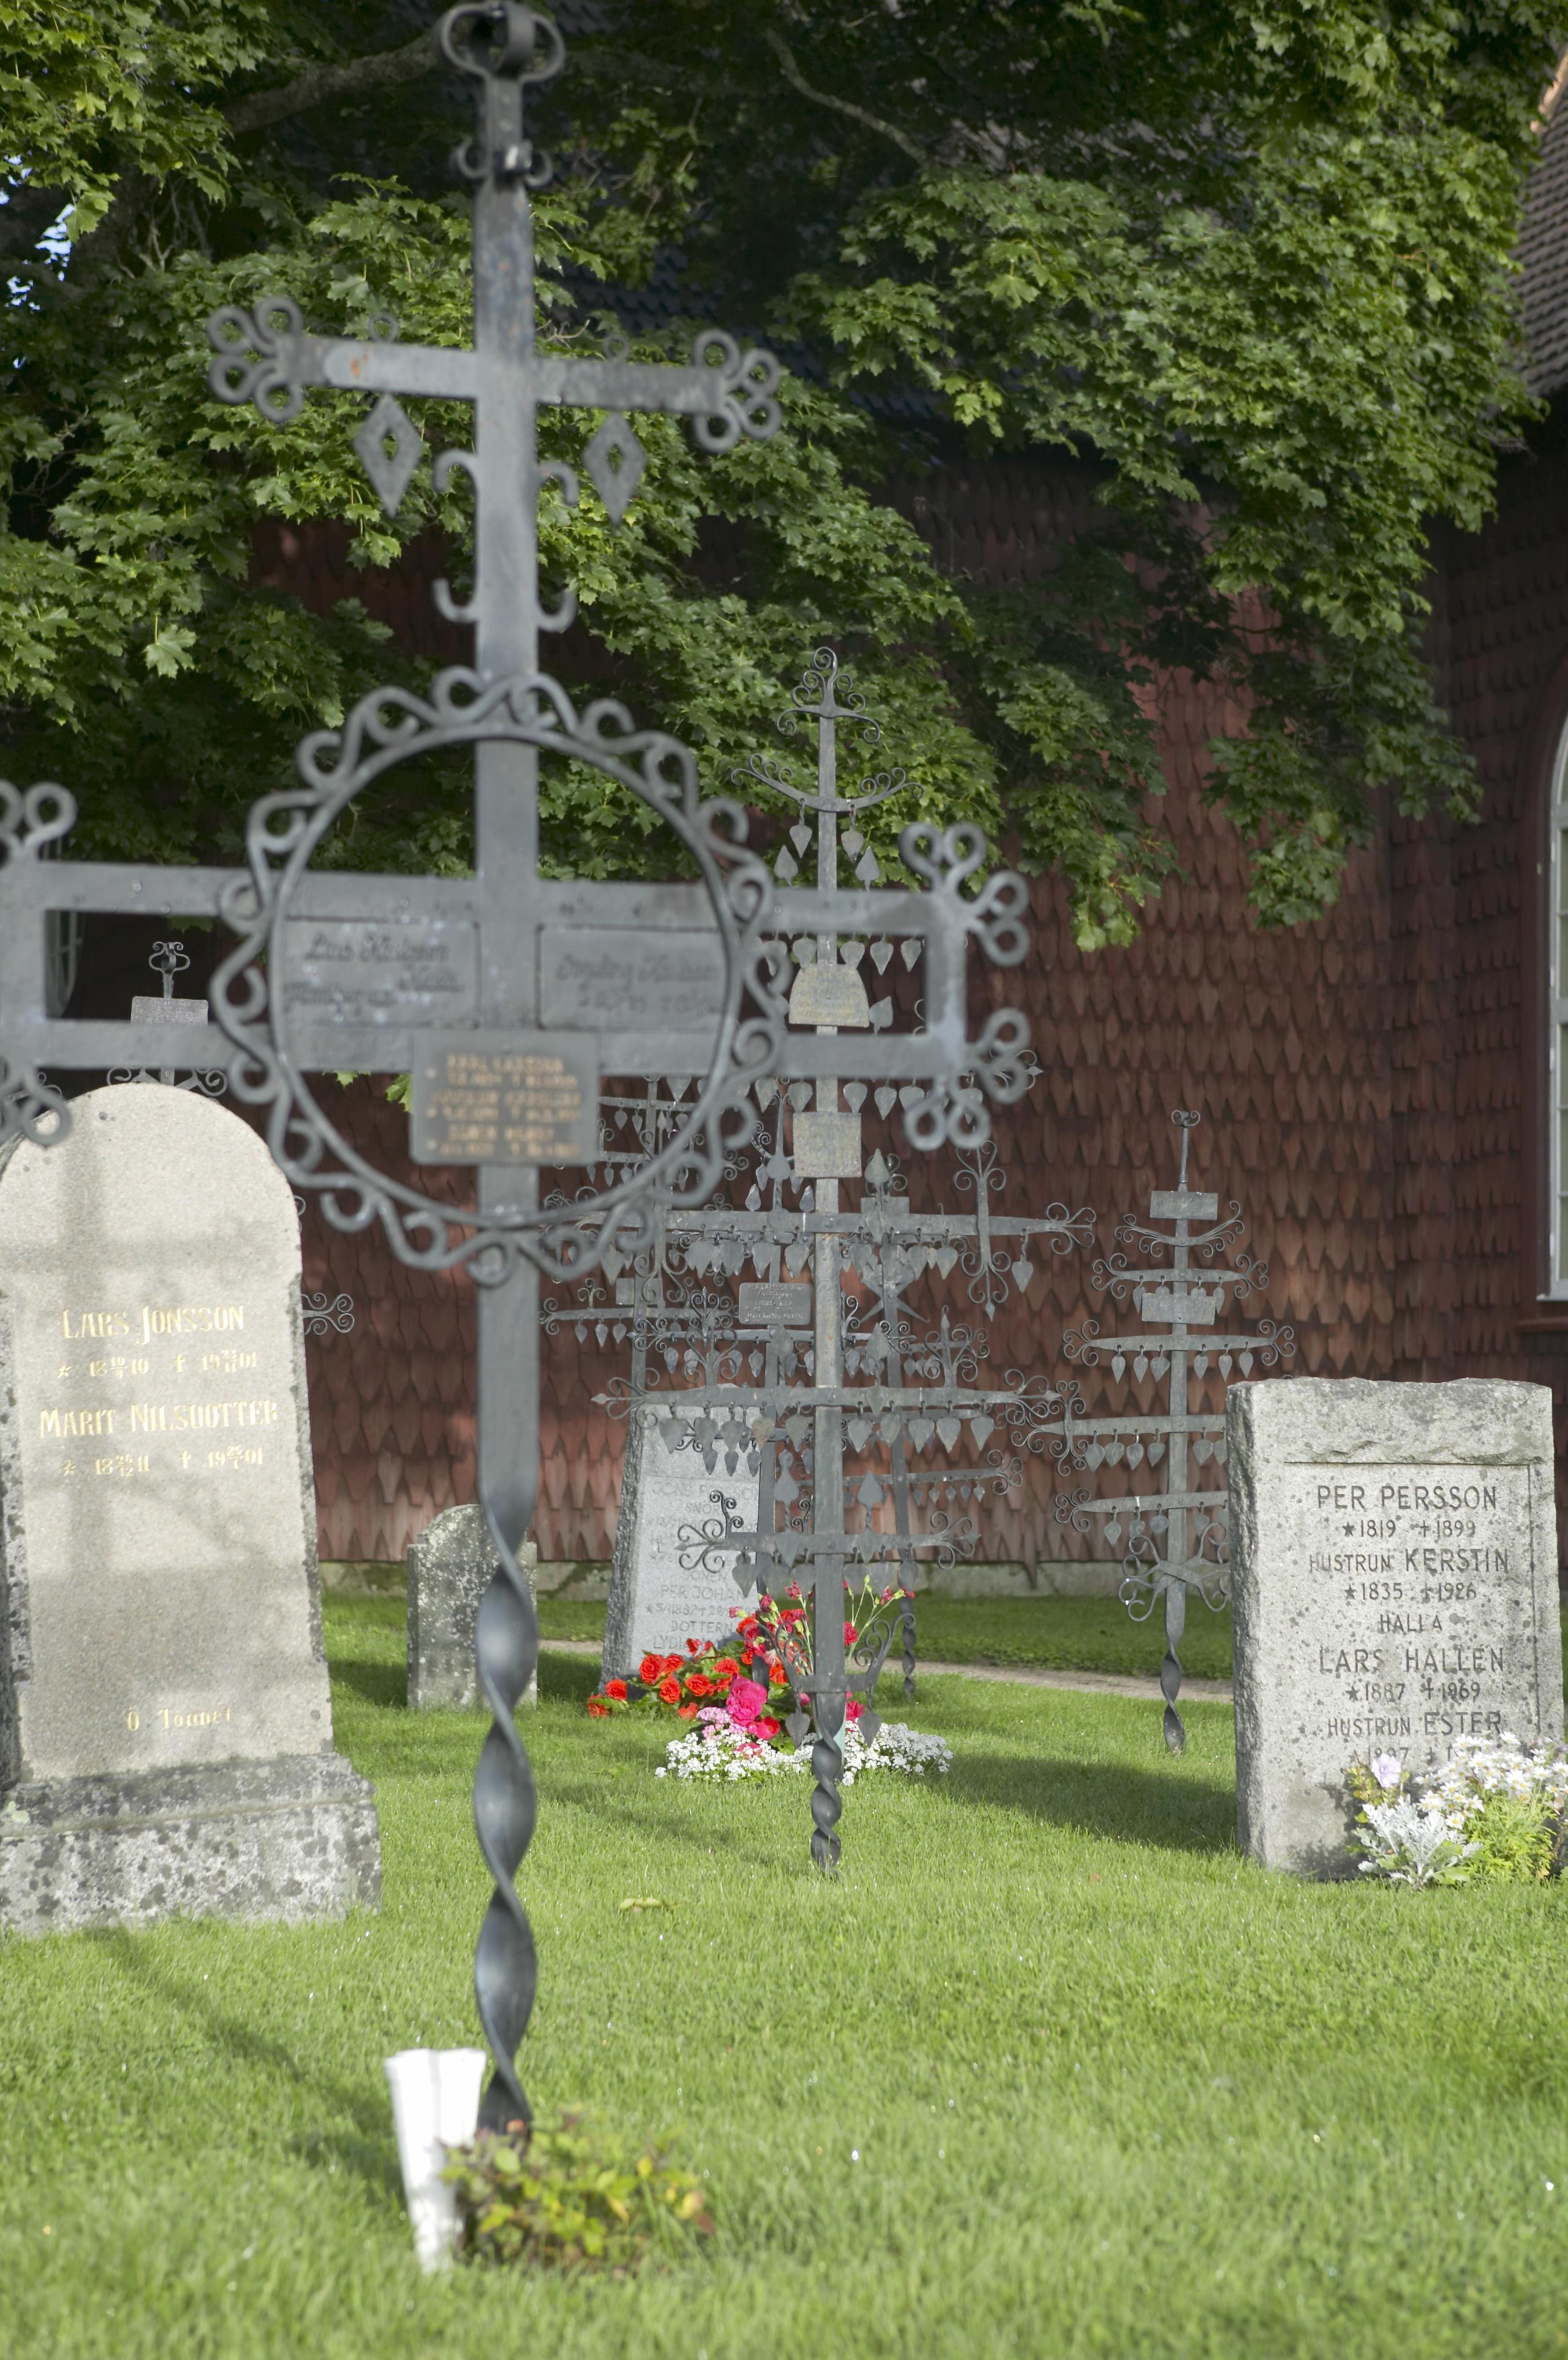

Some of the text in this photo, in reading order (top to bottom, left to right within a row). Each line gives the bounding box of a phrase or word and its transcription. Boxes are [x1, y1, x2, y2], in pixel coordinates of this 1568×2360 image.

[1317, 1485, 1497, 1510] PER PERSSON
[1309, 1548, 1509, 1573] HUSTRUN KERSTIN
[1380, 1614, 1443, 1632] HALLA
[1319, 1648, 1386, 1673] LARS
[1328, 1711, 1502, 1737] HUSTRUN ESTER
